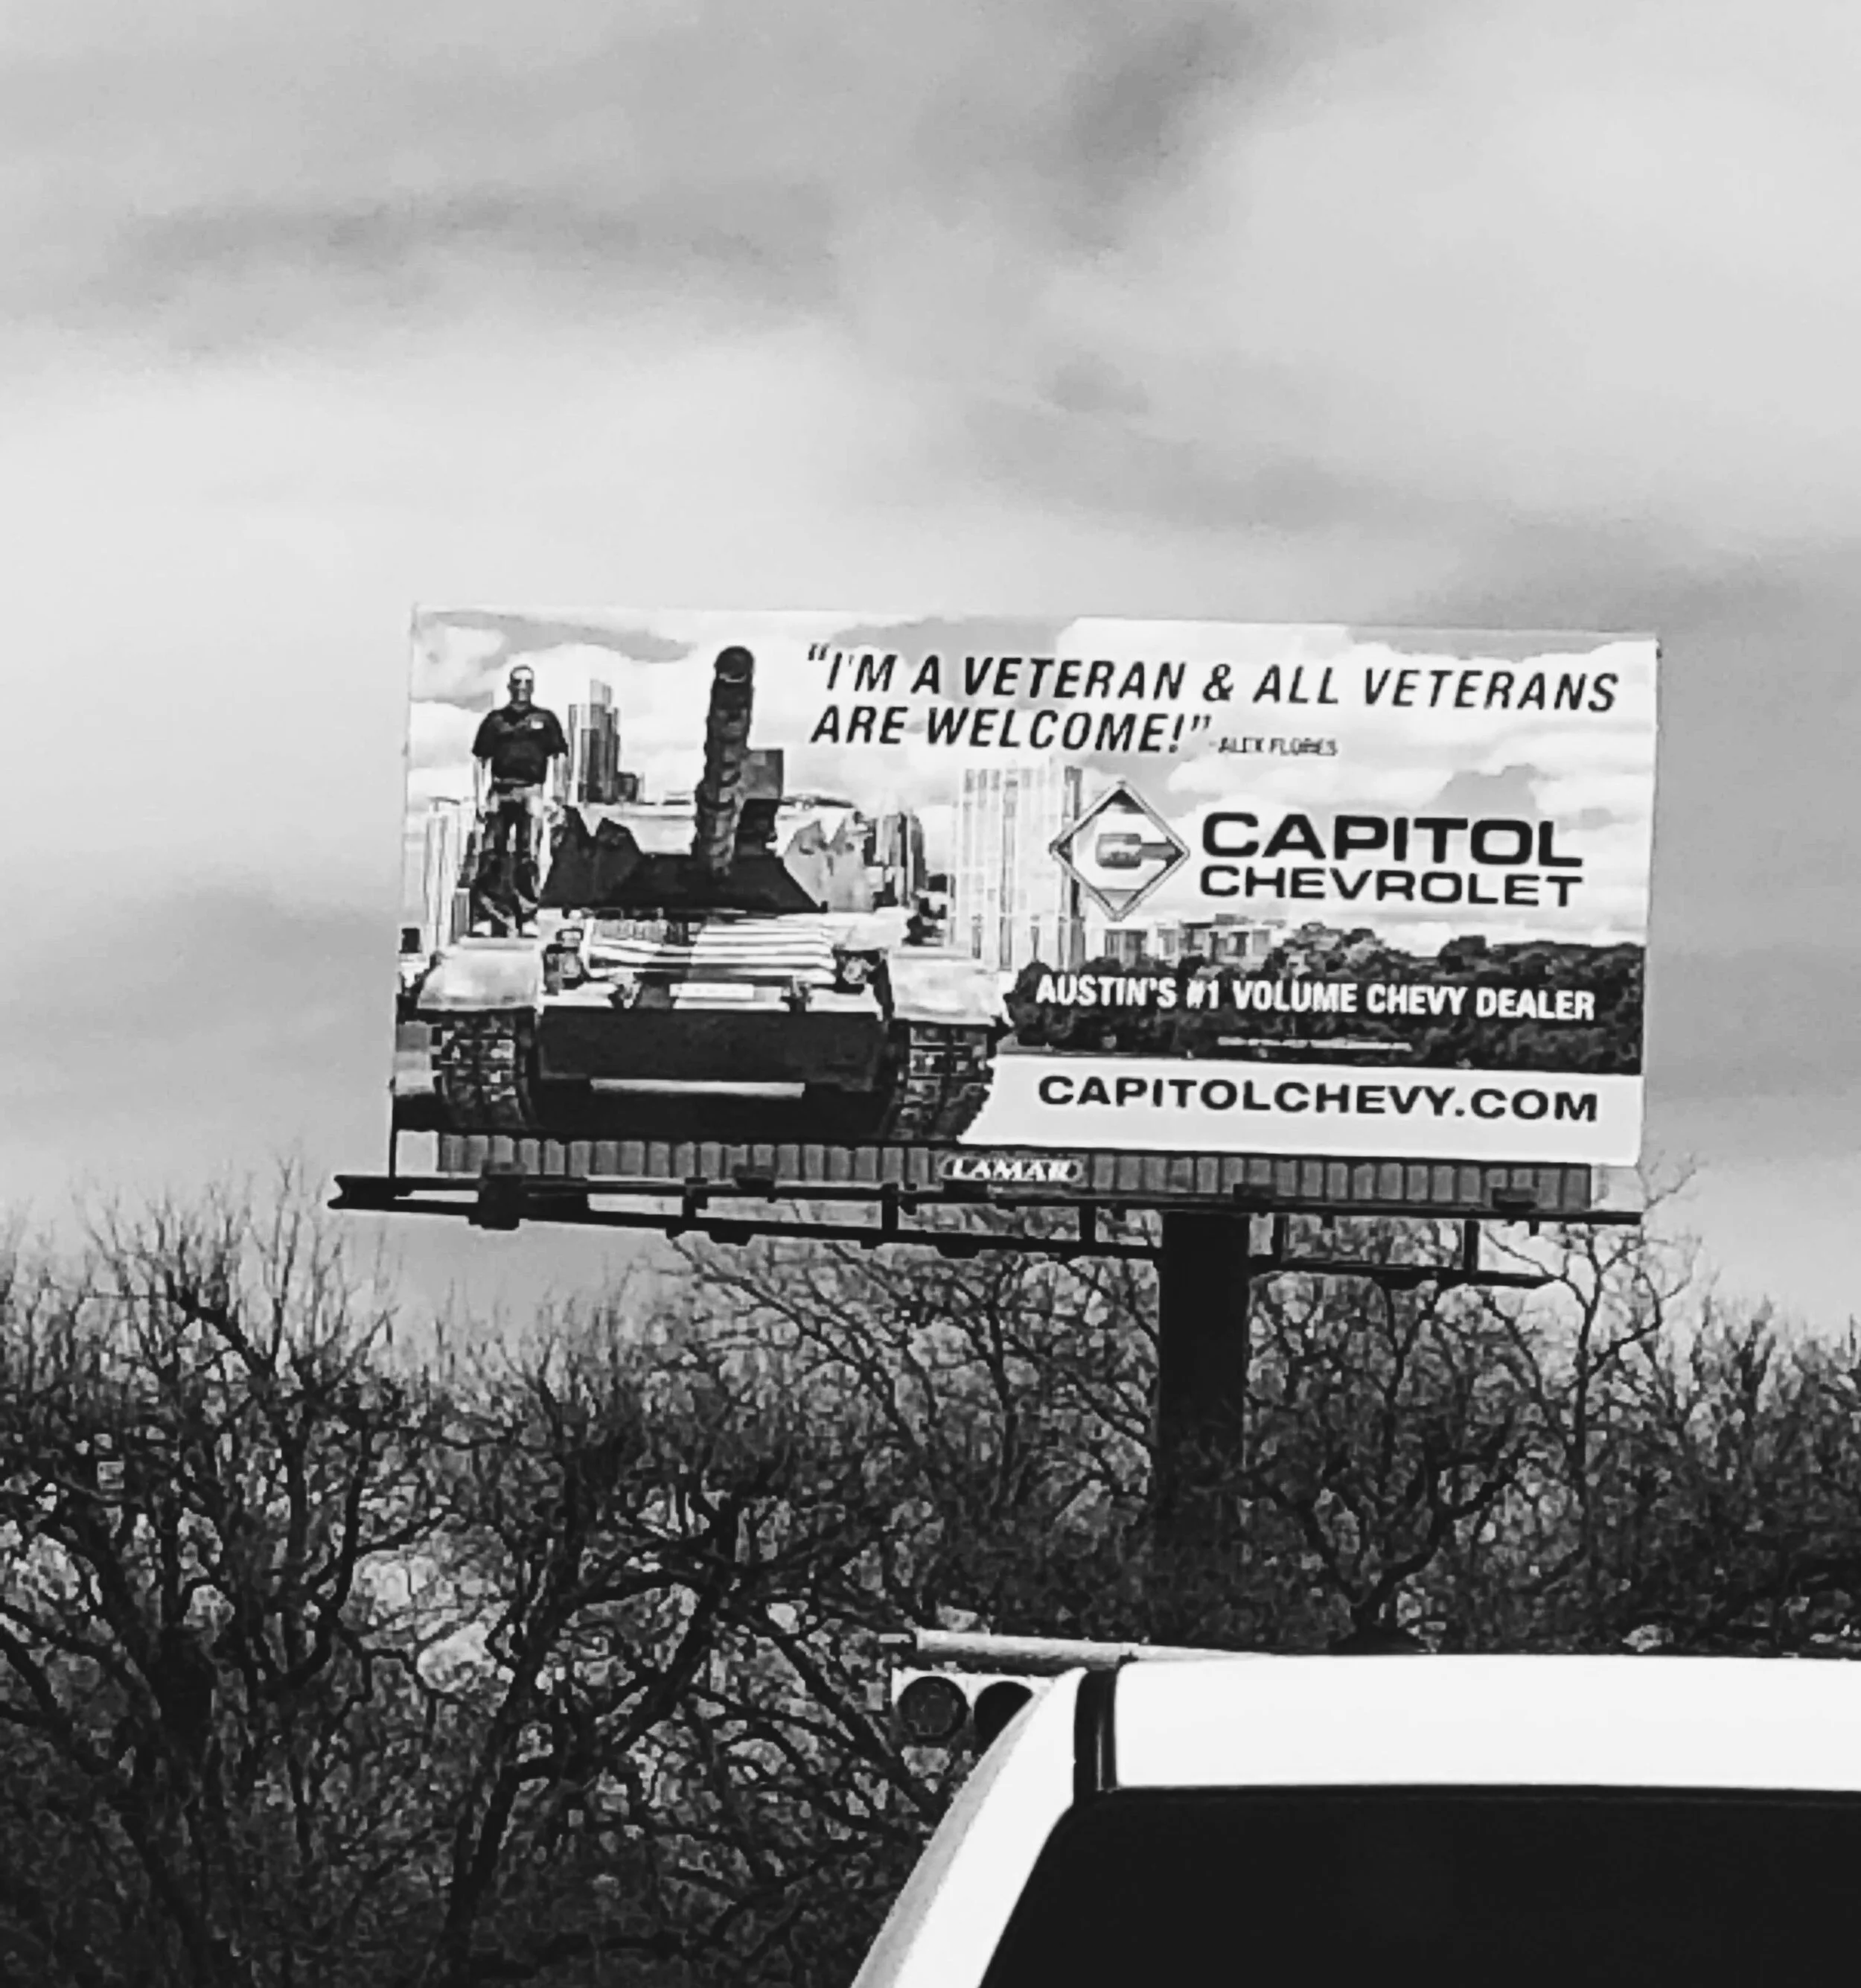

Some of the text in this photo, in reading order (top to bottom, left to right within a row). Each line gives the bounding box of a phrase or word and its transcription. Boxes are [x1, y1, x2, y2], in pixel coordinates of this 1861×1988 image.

[808, 643, 1619, 712] "I'M A VETERAN & ALL VETERANS
[810, 704, 1212, 753] ARE WELCOME!"
[1201, 812, 1583, 867] CAPITOL
[1199, 865, 1583, 907] CHEVROLET
[1035, 973, 1595, 1021] AUSTIN'S #1 VOLUME CHEVY DEALER
[1038, 1074, 1598, 1123] CAPITOLCHEVY.COM
[952, 1158, 1073, 1182] LAMAR
